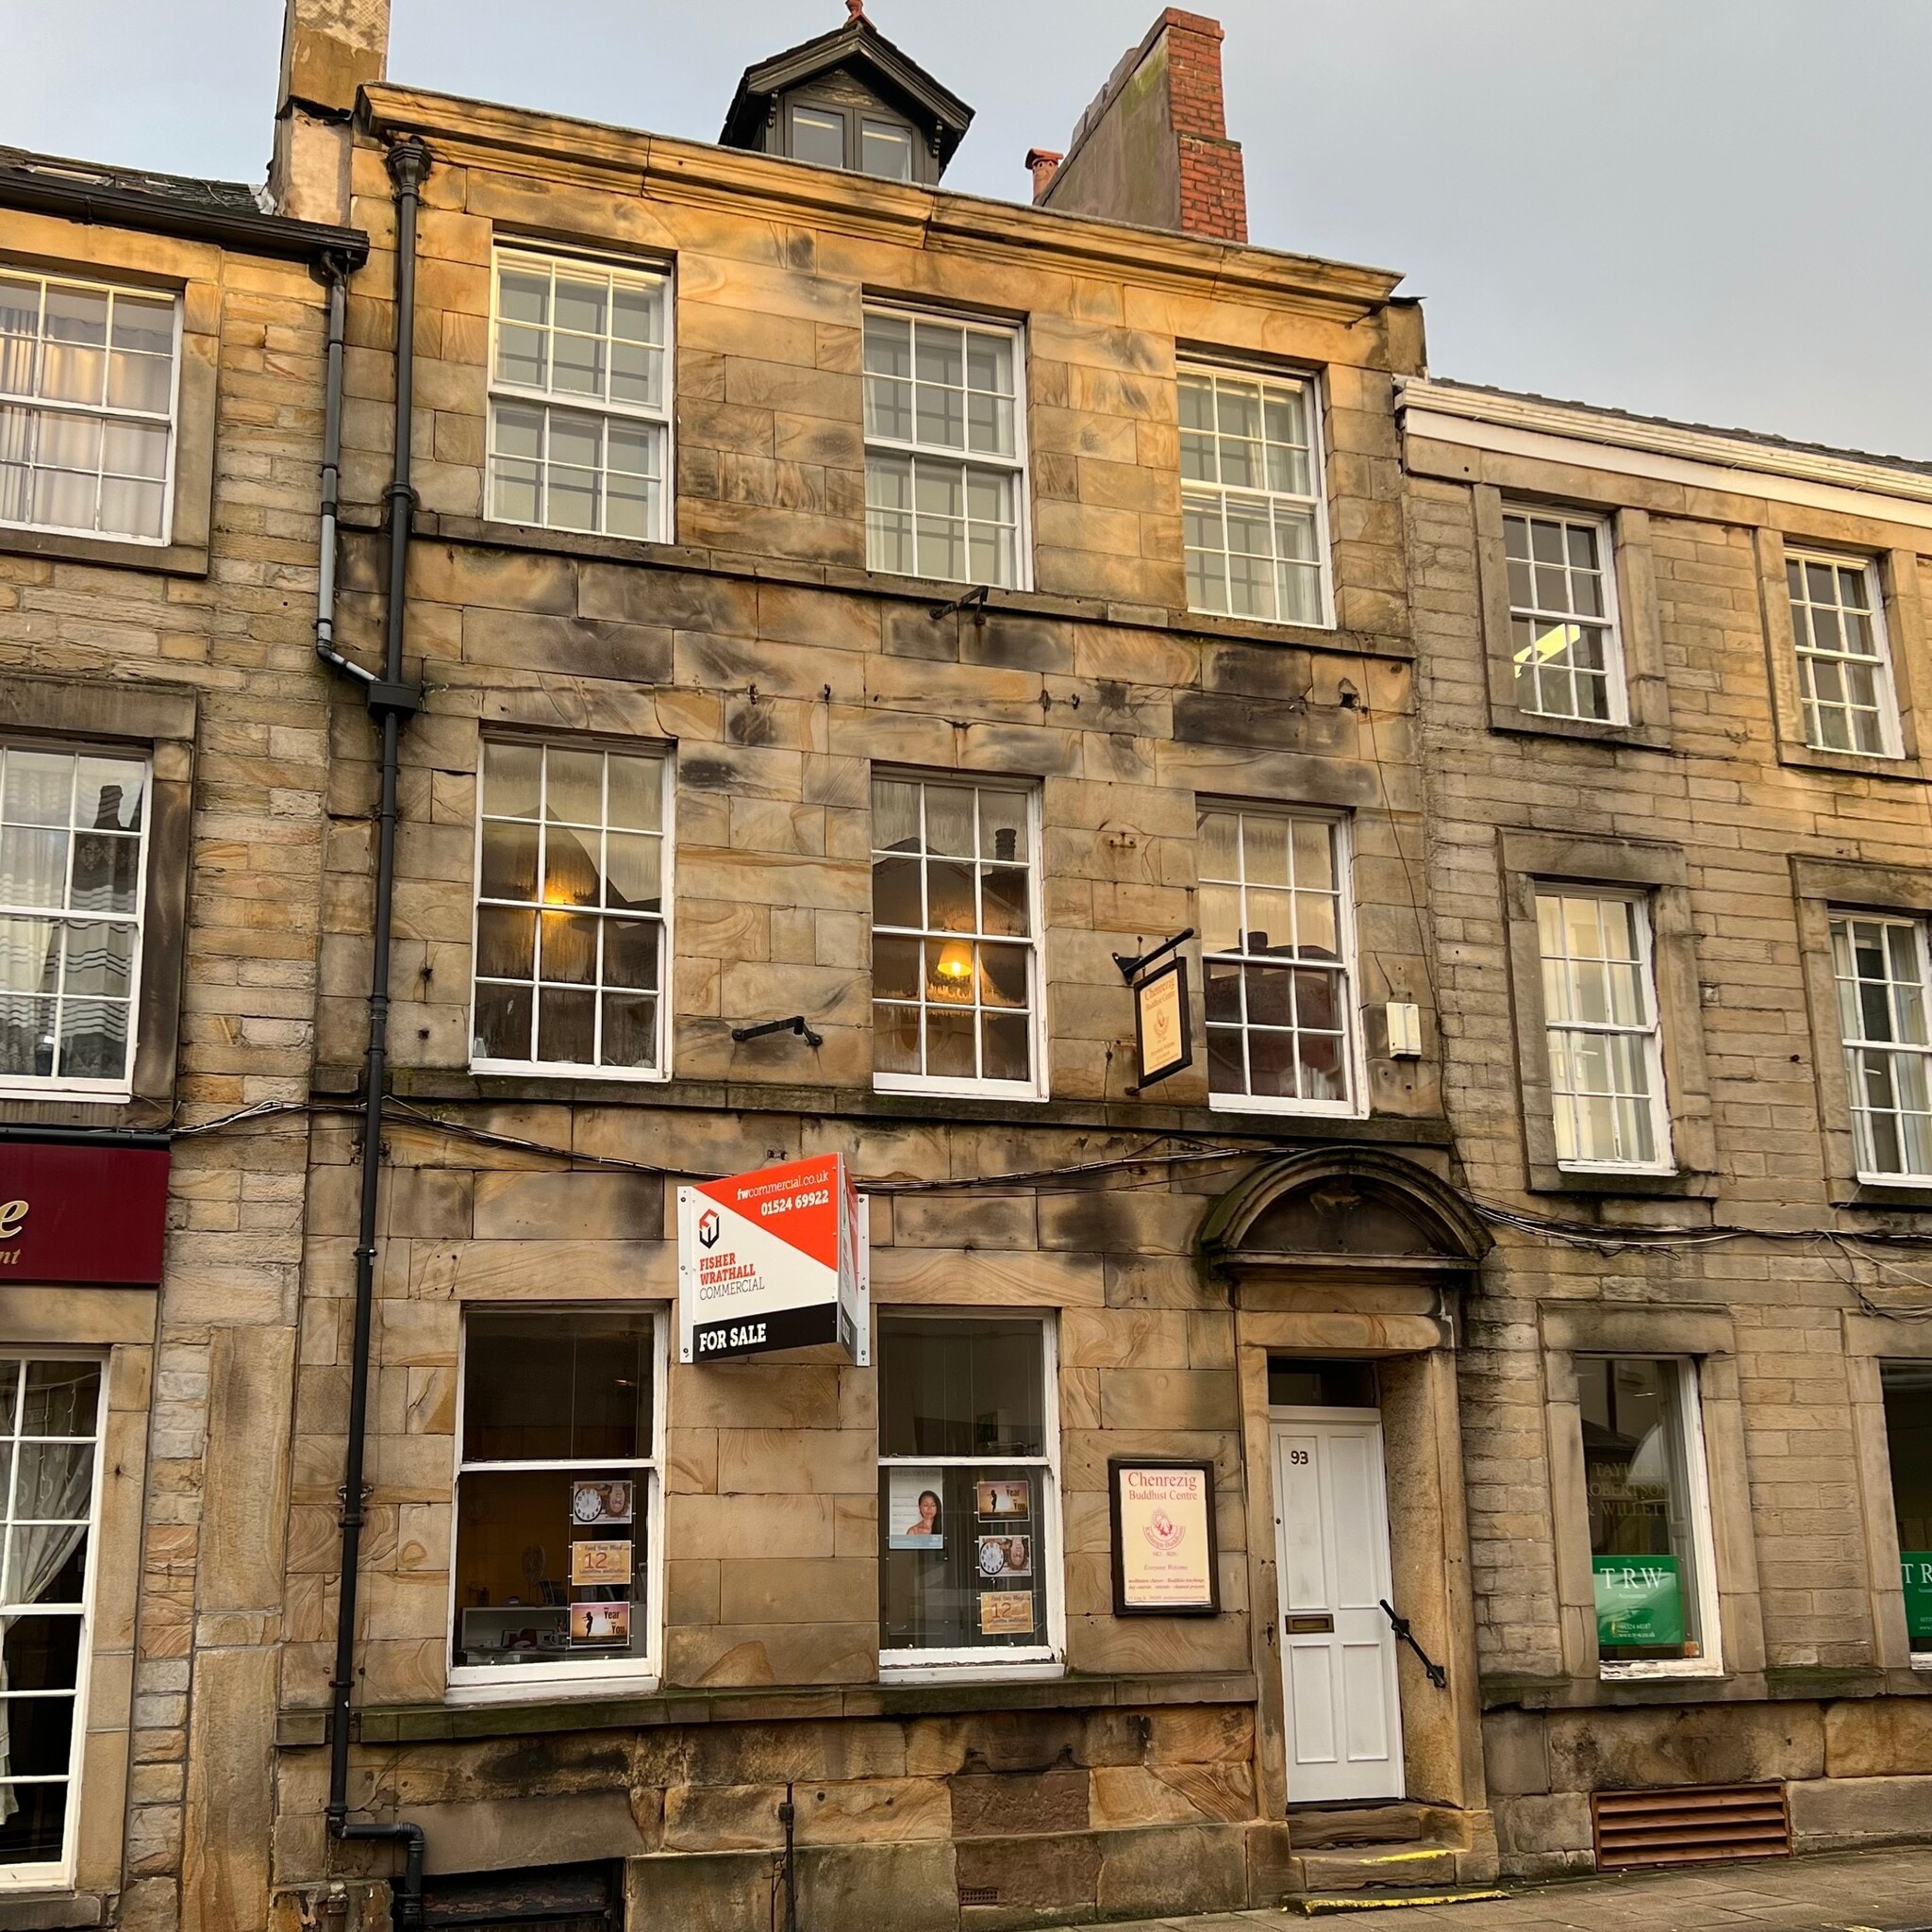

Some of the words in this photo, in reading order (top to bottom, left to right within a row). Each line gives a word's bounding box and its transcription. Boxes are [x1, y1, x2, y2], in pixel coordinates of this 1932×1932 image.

[737, 1170, 829, 1201] fwcommercial.co.uk
[760, 1197, 793, 1217] 01524
[795, 1189, 829, 1209] 69922
[699, 1252, 737, 1272] FISHER
[700, 1263, 757, 1286] WRATHALL
[699, 1276, 765, 1301] COMMERCIAL
[699, 1330, 727, 1353] FOR
[729, 1323, 767, 1347] SALE
[1291, 1450, 1309, 1465] 93
[1591, 1462, 1657, 1477] TAYLOR
[1128, 1472, 1197, 1491] Chenrezig
[1128, 1490, 1167, 1501] Buddhist
[1169, 1490, 1198, 1501] Centre
[584, 1552, 608, 1569] 12
[604, 1610, 621, 1620] Year
[991, 1602, 1012, 1618] 12
